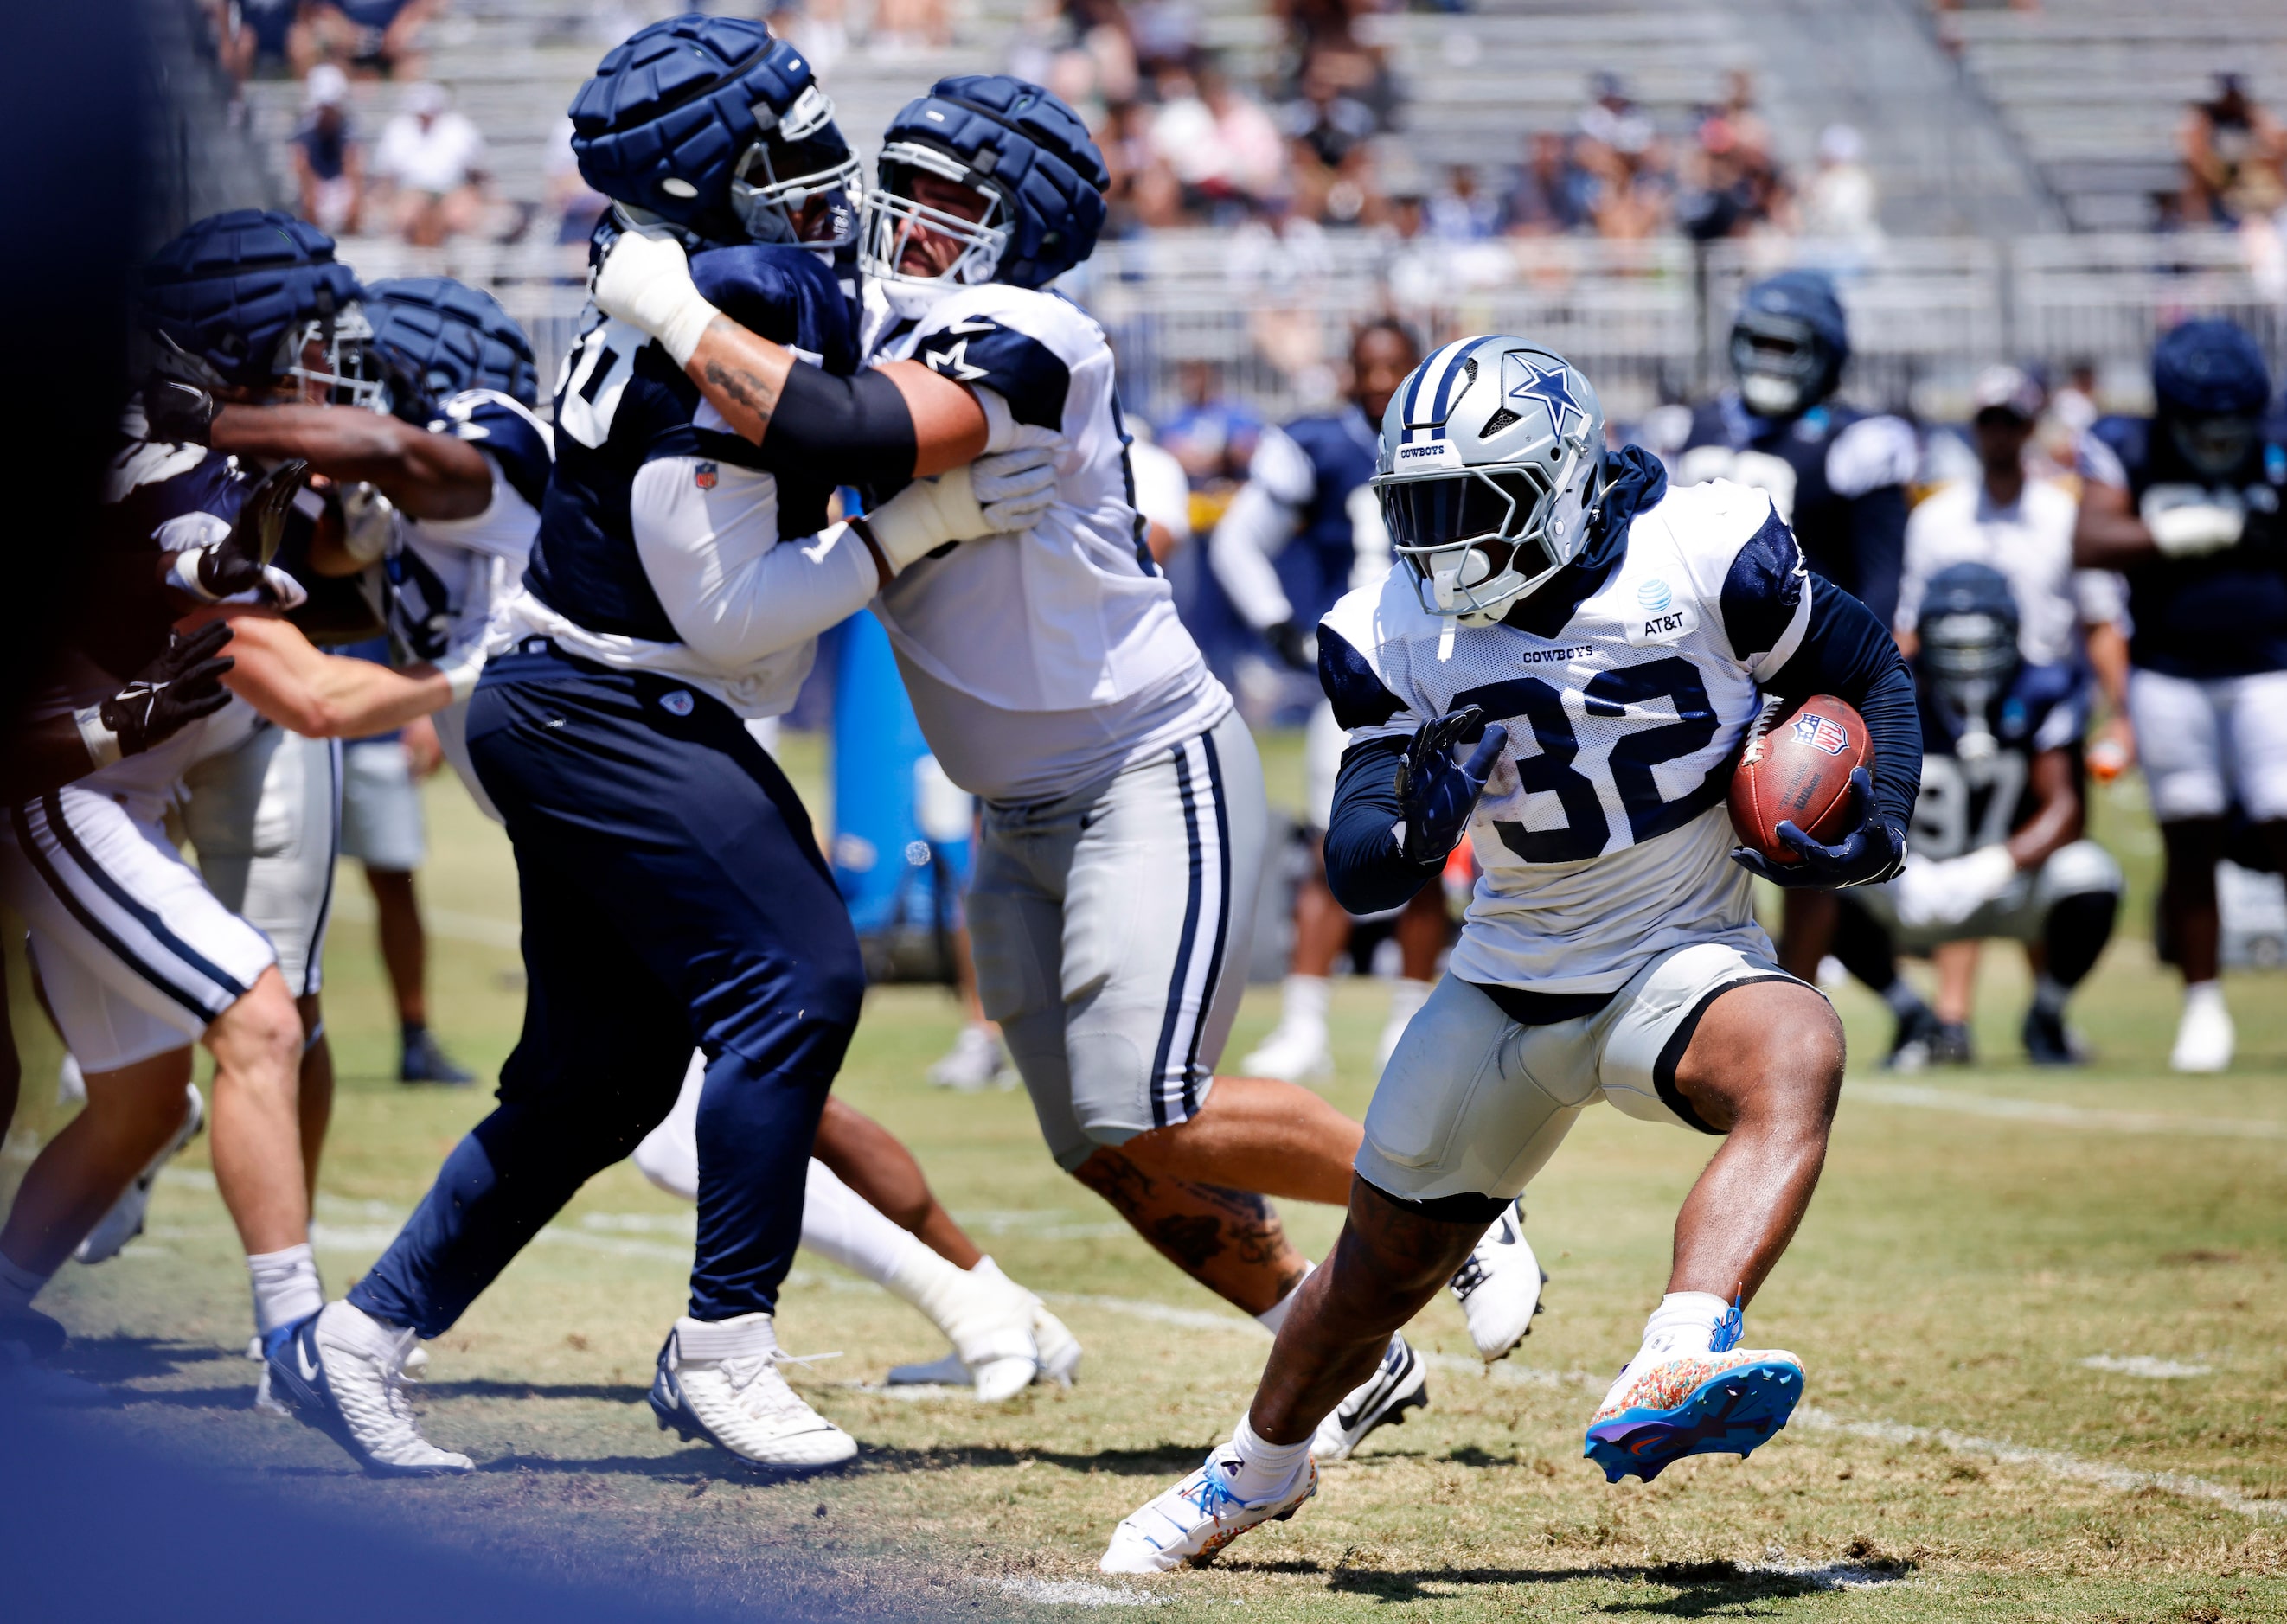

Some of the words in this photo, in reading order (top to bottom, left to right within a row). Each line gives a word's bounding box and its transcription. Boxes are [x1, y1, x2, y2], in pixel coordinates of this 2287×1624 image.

[1400, 444, 1445, 459] COWBOYS
[1644, 611, 1684, 637] AT&T
[1522, 645, 1593, 663] COWBOYS
[1815, 723, 1843, 751] NFL
[1446, 655, 1728, 864] 32
[1909, 748, 2026, 863] 97
